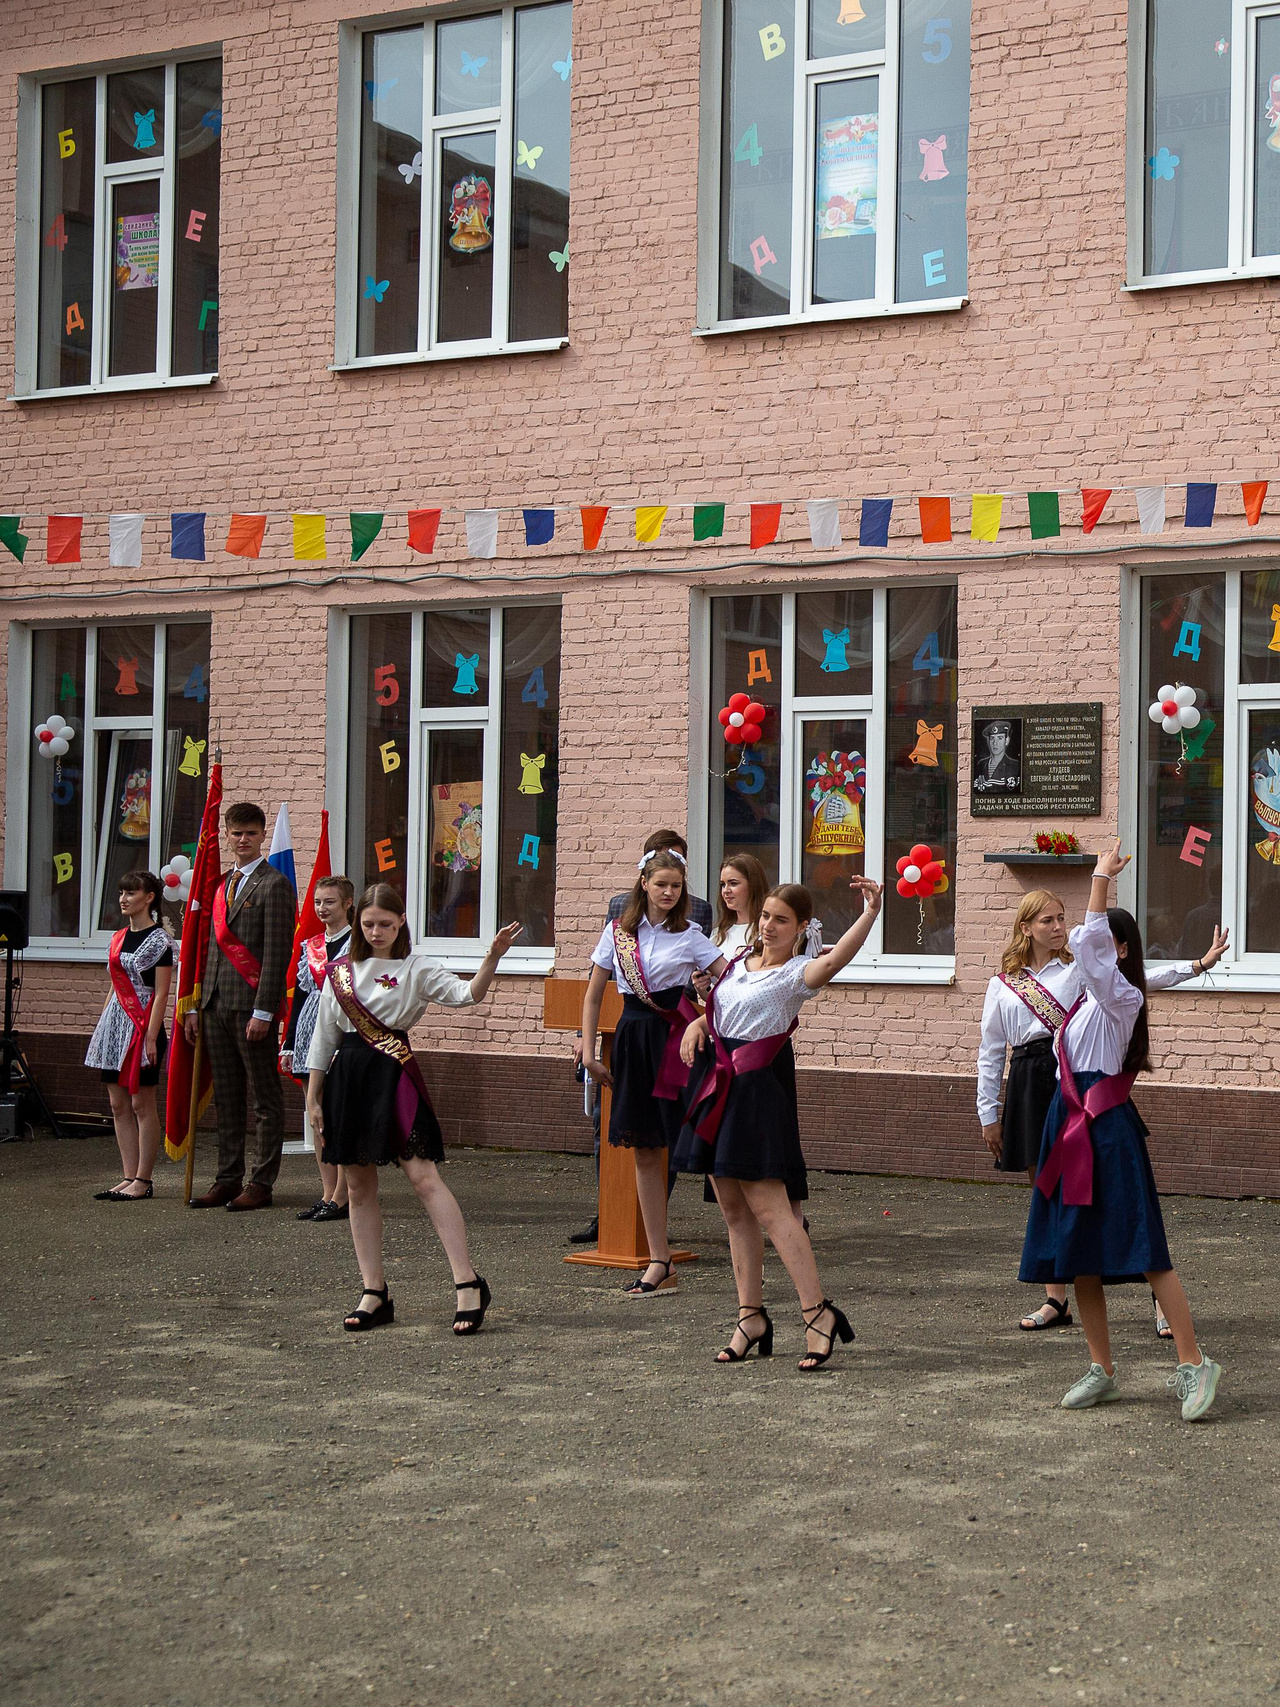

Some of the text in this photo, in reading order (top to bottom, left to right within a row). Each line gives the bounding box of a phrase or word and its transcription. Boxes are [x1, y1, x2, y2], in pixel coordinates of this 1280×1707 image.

[758, 22, 786, 62] В
[922, 18, 952, 64] 5
[57, 128, 76, 159] Б
[734, 122, 764, 166] 4
[46, 213, 69, 252] 4
[184, 209, 207, 242] Е
[750, 234, 778, 276] Д
[922, 248, 947, 288] Е
[65, 301, 85, 336] Д
[912, 632, 944, 677] 4
[1172, 620, 1202, 662] Д
[60, 672, 78, 700] А
[184, 664, 207, 704] 4
[374, 663, 400, 706] 5
[521, 666, 548, 708] 4
[747, 648, 772, 686] Д
[378, 740, 401, 774] Б
[736, 750, 765, 795] 5
[374, 838, 397, 872] Е
[518, 832, 540, 870] Д
[1178, 824, 1212, 868] Е
[53, 852, 74, 884] В
[374, 1033, 414, 1065] 2021
